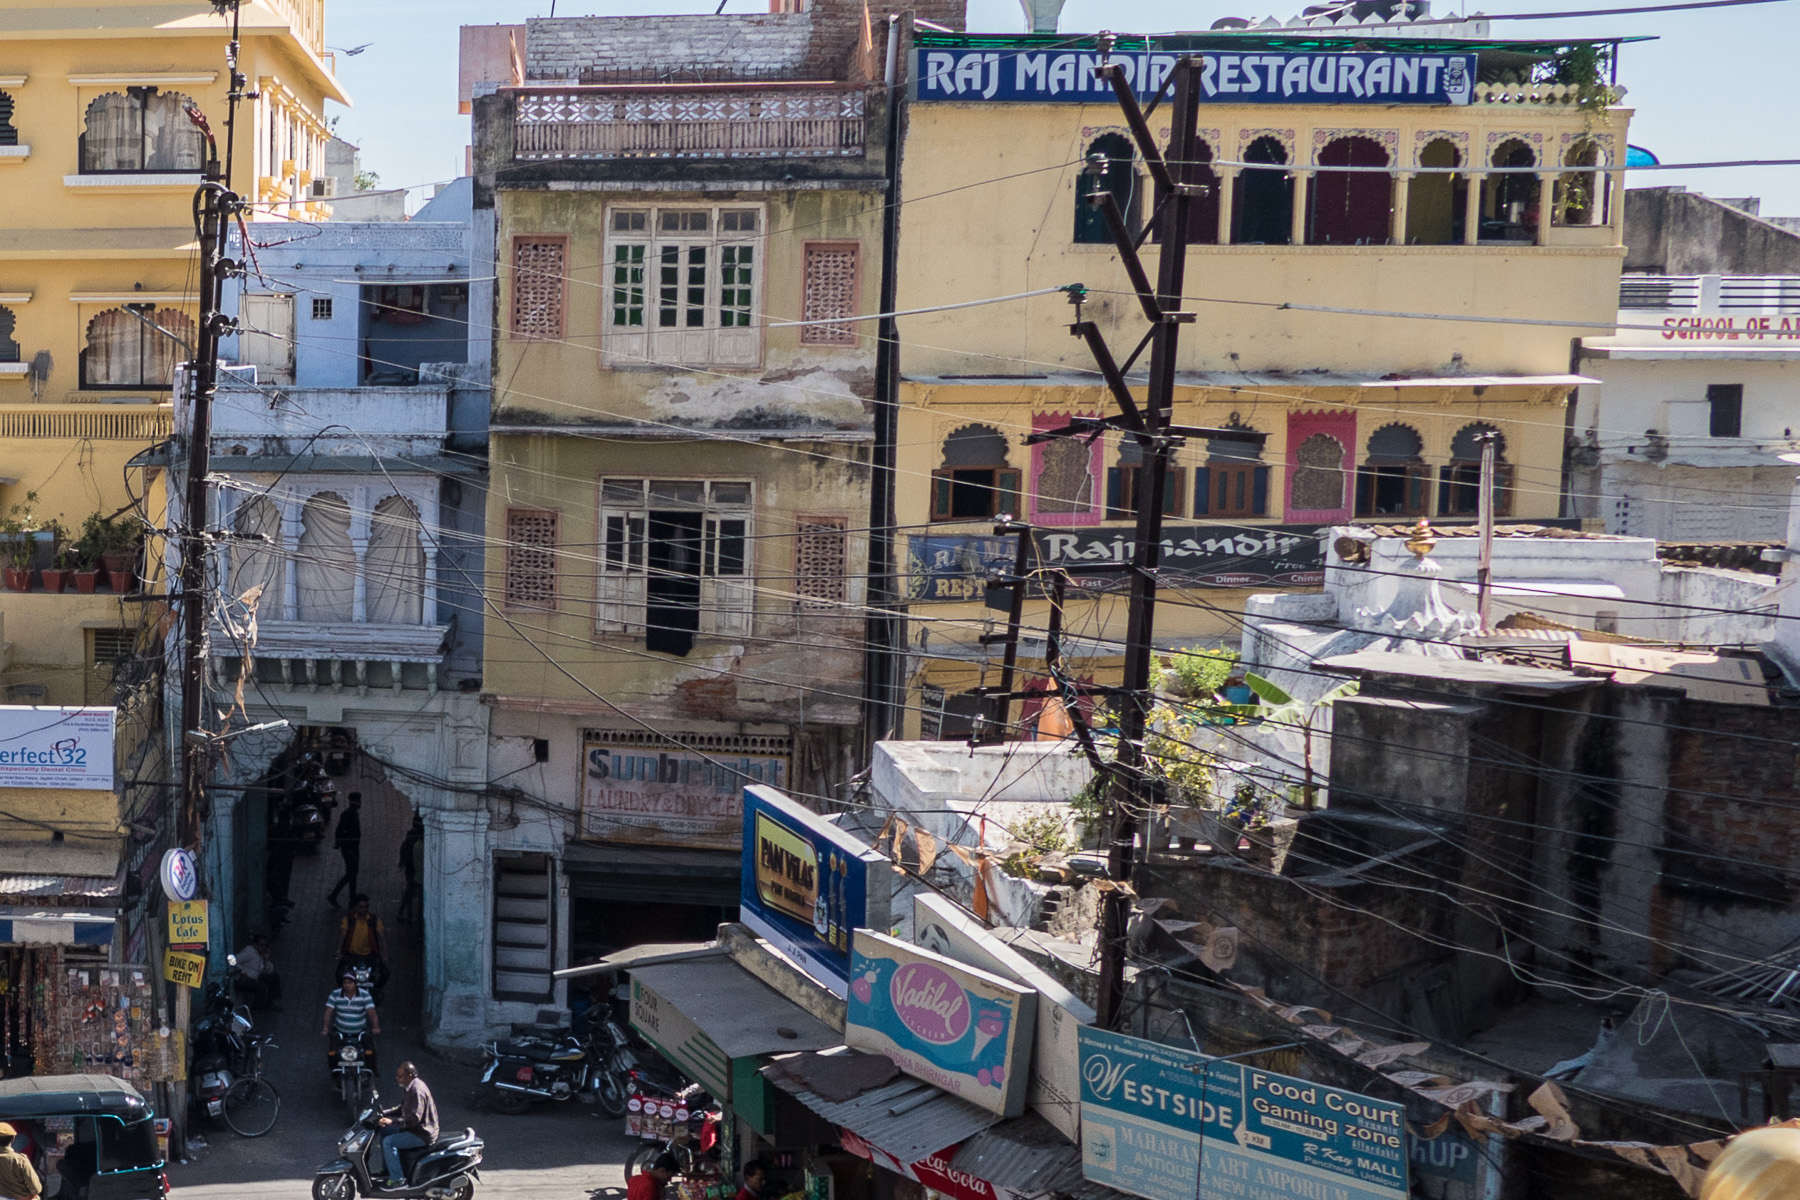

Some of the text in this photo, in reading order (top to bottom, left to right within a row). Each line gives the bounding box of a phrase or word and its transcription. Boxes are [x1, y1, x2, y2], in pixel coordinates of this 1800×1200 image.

[927, 52, 1001, 98] RAJ
[1200, 56, 1445, 98] RESTAURANT
[1662, 317, 1740, 340] SCHOOL
[1747, 317, 1771, 340] OF
[1216, 576, 1251, 584] Dinner
[62, 748, 87, 765] 32
[588, 748, 784, 795] Sunbright
[761, 835, 783, 875] PAN
[171, 913, 204, 925] Lotus
[176, 926, 199, 940] Cafe
[169, 956, 200, 974] BIKE ON
[172, 970, 193, 984] RENT
[640, 987, 658, 1013] FOUR
[895, 968, 964, 1036] Vadilal
[635, 1001, 660, 1034] SQUARE
[884, 1047, 913, 1071] SUDHA
[1083, 1053, 1234, 1130] WESTSIDE
[1252, 1072, 1400, 1127] Food Court
[1252, 1097, 1400, 1148] Gaming zone
[1243, 1132, 1265, 1146] 2 KM
[1217, 1156, 1250, 1180] ART
[1303, 1142, 1402, 1179] R Kay MALL
[1134, 1151, 1195, 1181] ANTIQUE
[1212, 1175, 1246, 1197] NEW
[1361, 1170, 1400, 1188] Udaipur
